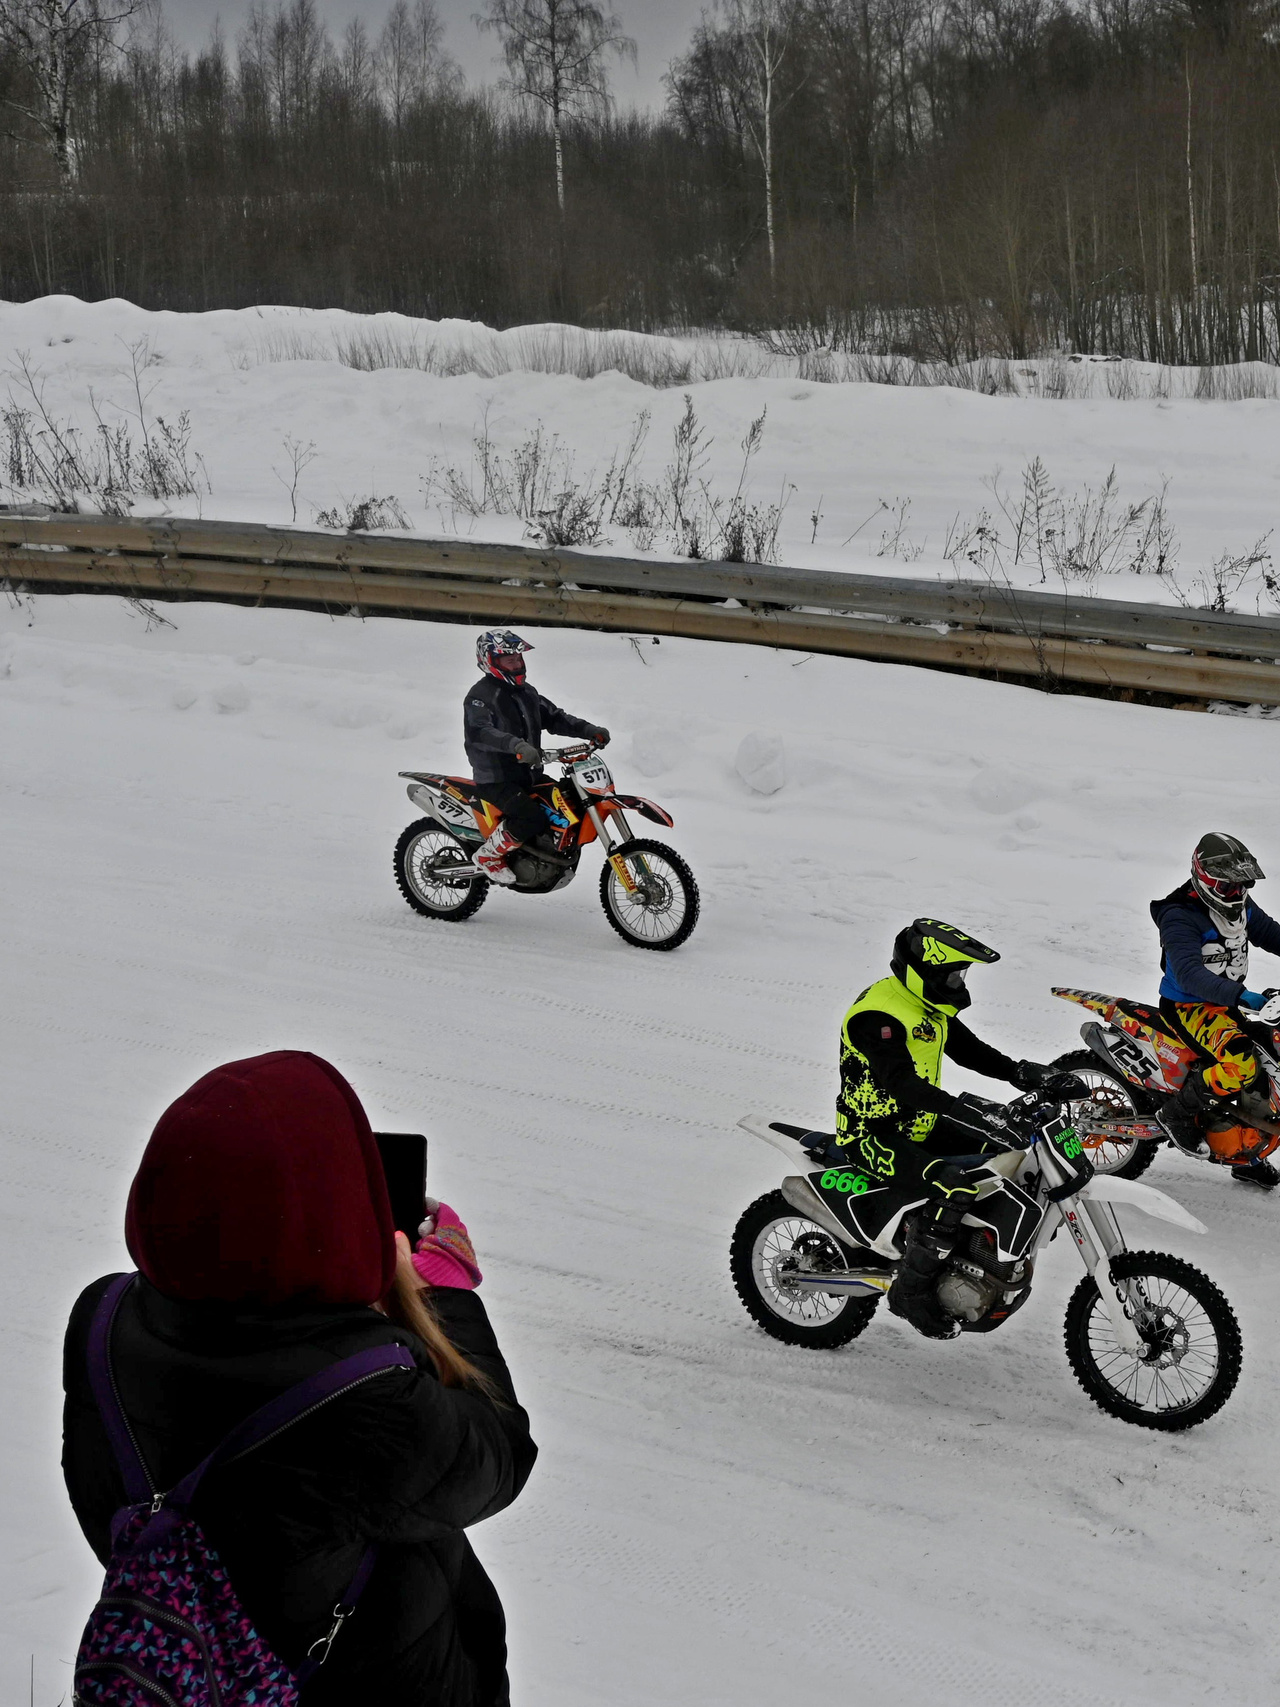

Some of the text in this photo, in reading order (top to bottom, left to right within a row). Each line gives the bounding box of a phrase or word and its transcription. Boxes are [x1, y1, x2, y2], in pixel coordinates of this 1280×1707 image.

[582, 767, 606, 784] 577
[438, 801, 463, 818] 577
[612, 855, 637, 891] PIRELLI
[1108, 1038, 1159, 1080] 125
[820, 1169, 870, 1195] 666
